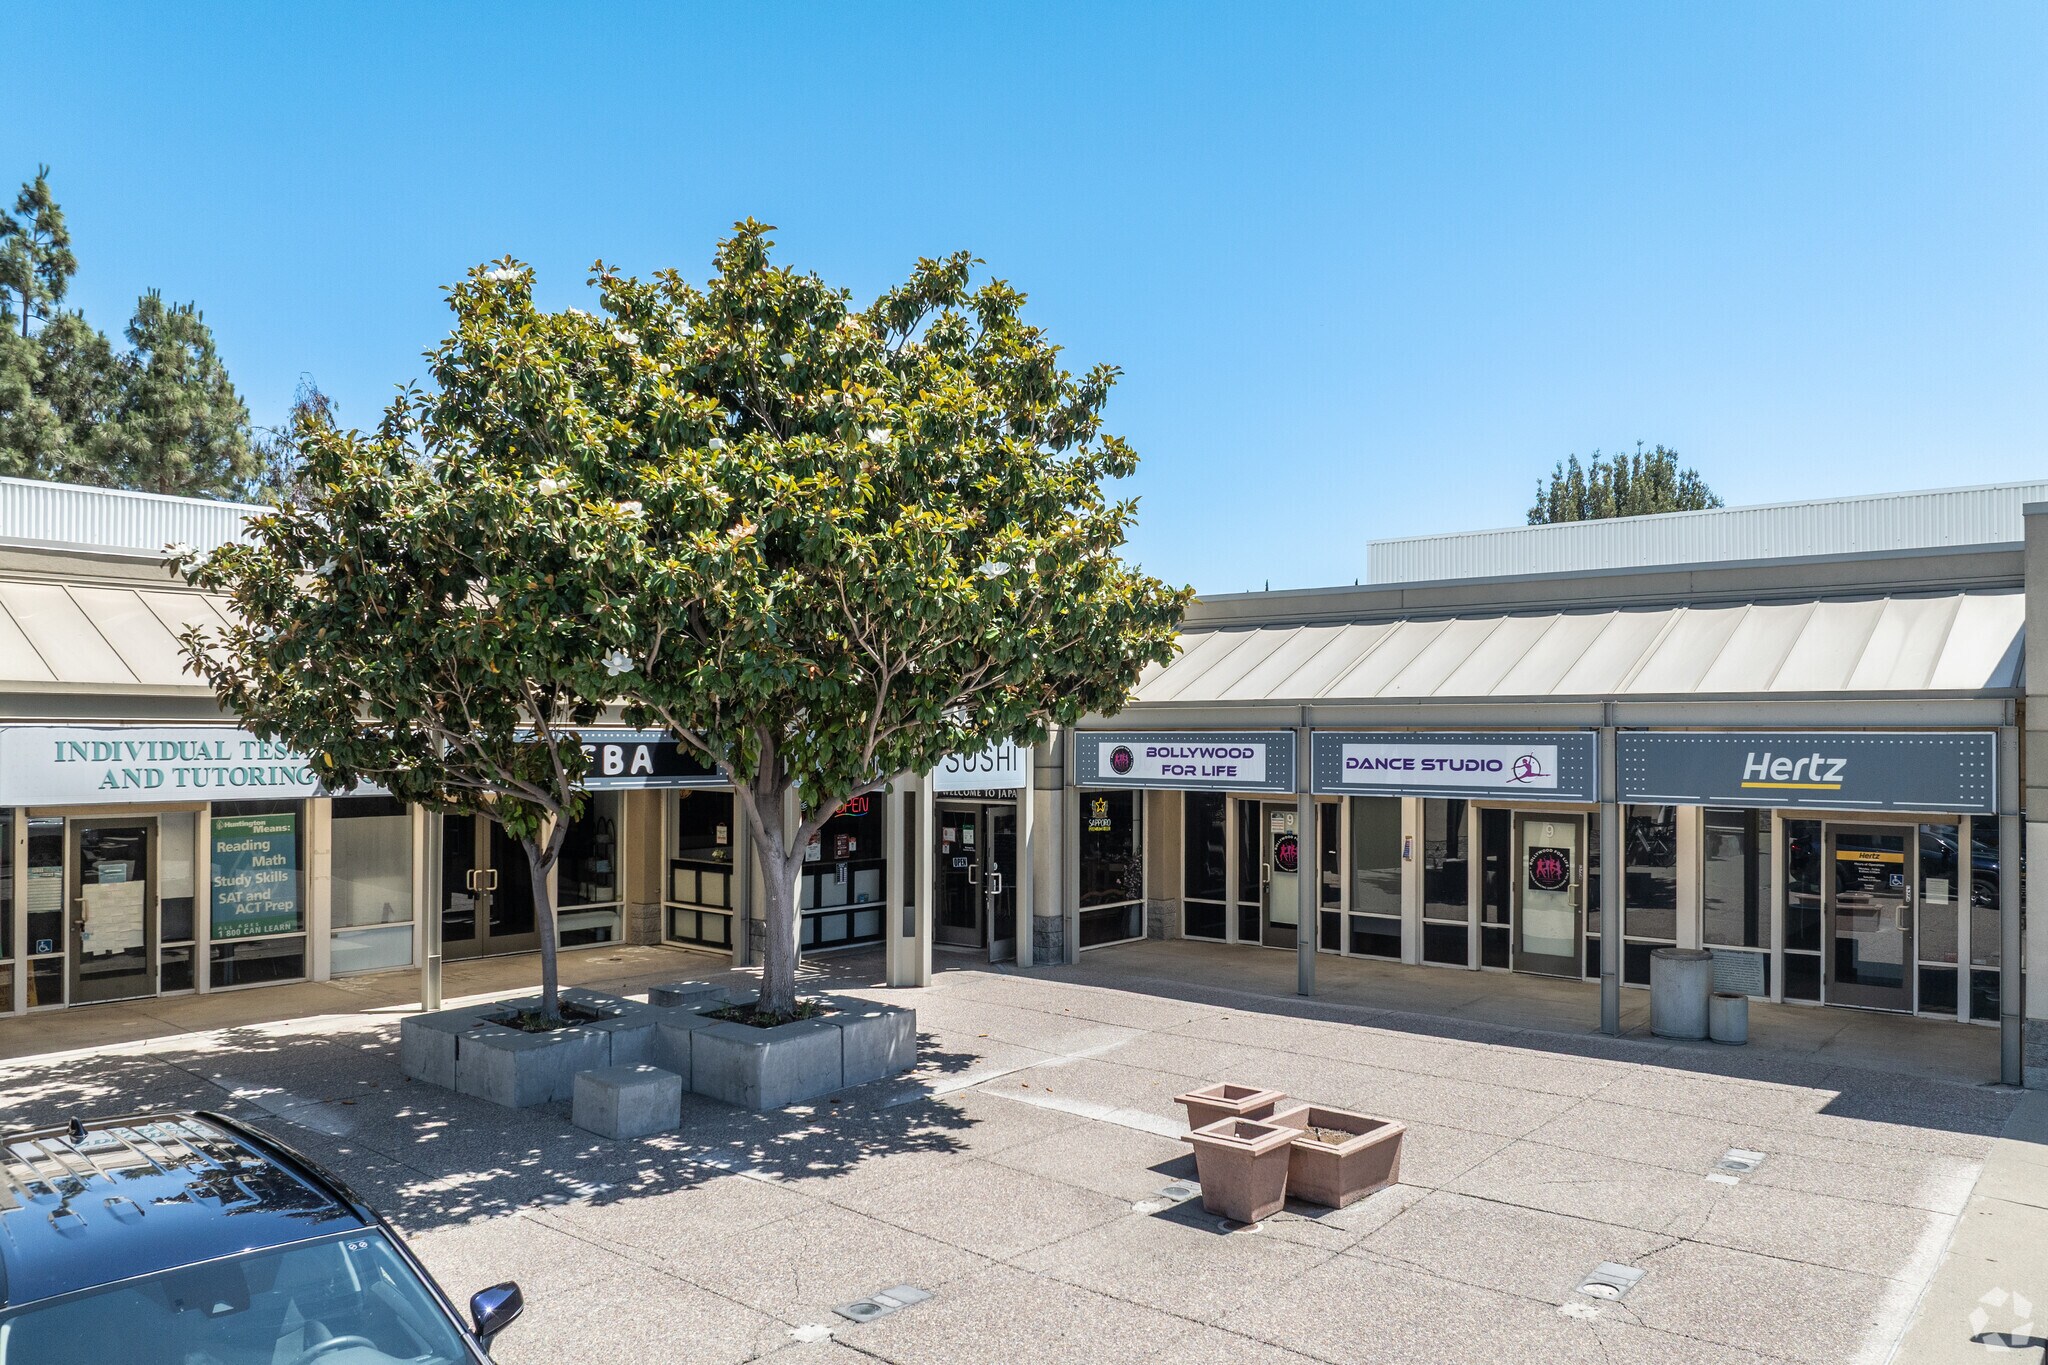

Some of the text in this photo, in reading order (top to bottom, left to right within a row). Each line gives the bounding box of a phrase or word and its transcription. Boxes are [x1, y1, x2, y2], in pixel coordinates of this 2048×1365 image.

[54, 740, 231, 762] INDIVIDUAL
[1146, 747, 1255, 759] BOLLYWOOD
[946, 745, 1017, 773] SUSHI
[1346, 757, 1503, 772] DANCE STUDIO
[1162, 765, 1238, 777] FOR LIFE
[1742, 752, 1848, 782] Hertz
[98, 764, 316, 789] AND TUTORING
[985, 789, 996, 797] TO
[835, 797, 869, 813] OPEN
[224, 820, 266, 828] Huntington
[1088, 818, 1112, 827] SAPPORO
[1286, 813, 1294, 826] 9
[253, 825, 291, 833] Means:
[1545, 824, 1554, 838] 9
[217, 839, 271, 853] Reading
[252, 854, 287, 867] Math
[1859, 852, 1881, 860] Hertz
[214, 870, 289, 888] Study Skills
[218, 888, 271, 904] SAT and
[235, 900, 294, 915] ACT Prep
[225, 928, 241, 937] 800
[243, 926, 261, 935] CAN
[264, 923, 291, 933] LEARN
